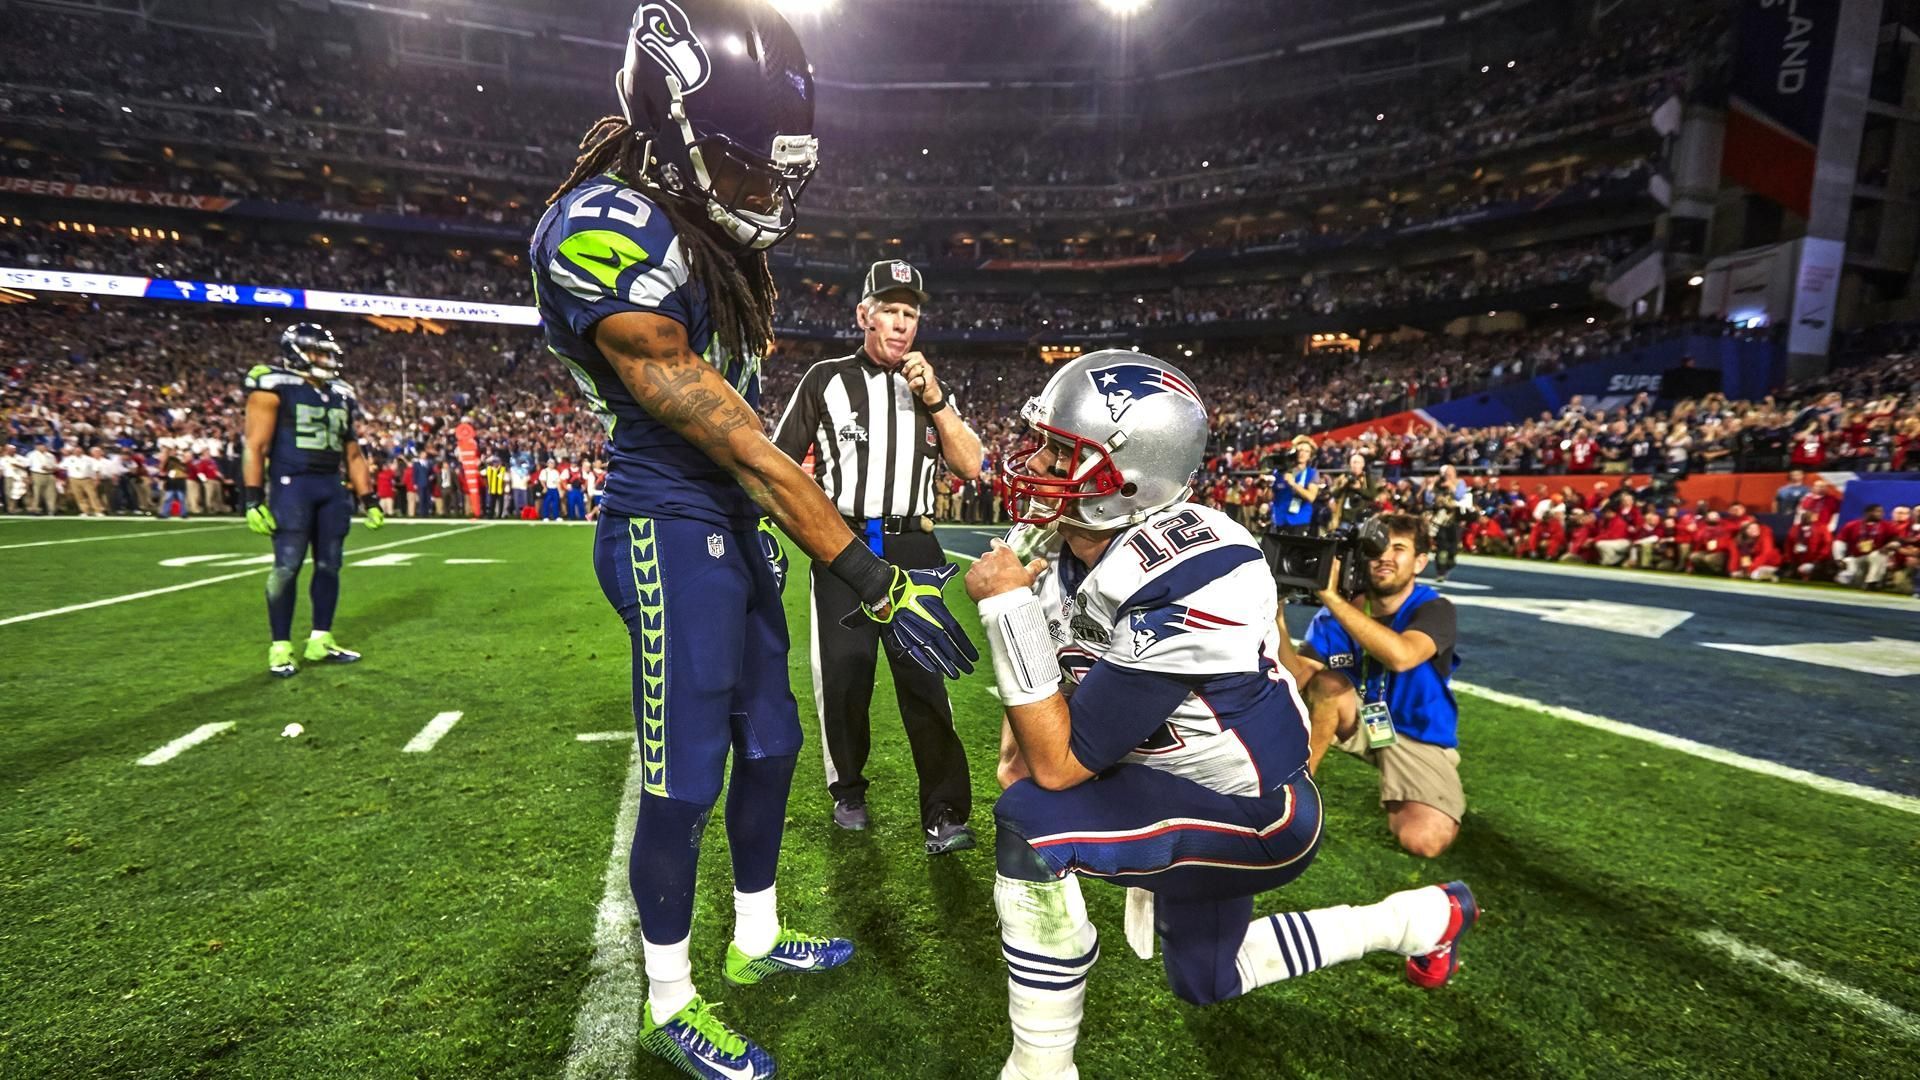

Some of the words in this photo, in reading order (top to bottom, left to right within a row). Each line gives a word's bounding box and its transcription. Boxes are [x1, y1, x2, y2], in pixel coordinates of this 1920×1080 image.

[71, 184, 142, 204] BOWL
[149, 191, 205, 209] XLIX
[568, 184, 658, 229] 25
[205, 283, 239, 303] 24
[340, 298, 409, 312] SEATTLE
[415, 303, 500, 318] SEAHAWKS
[839, 431, 868, 442] XLIX
[1124, 509, 1219, 573] 12
[1331, 655, 1353, 667] SDS
